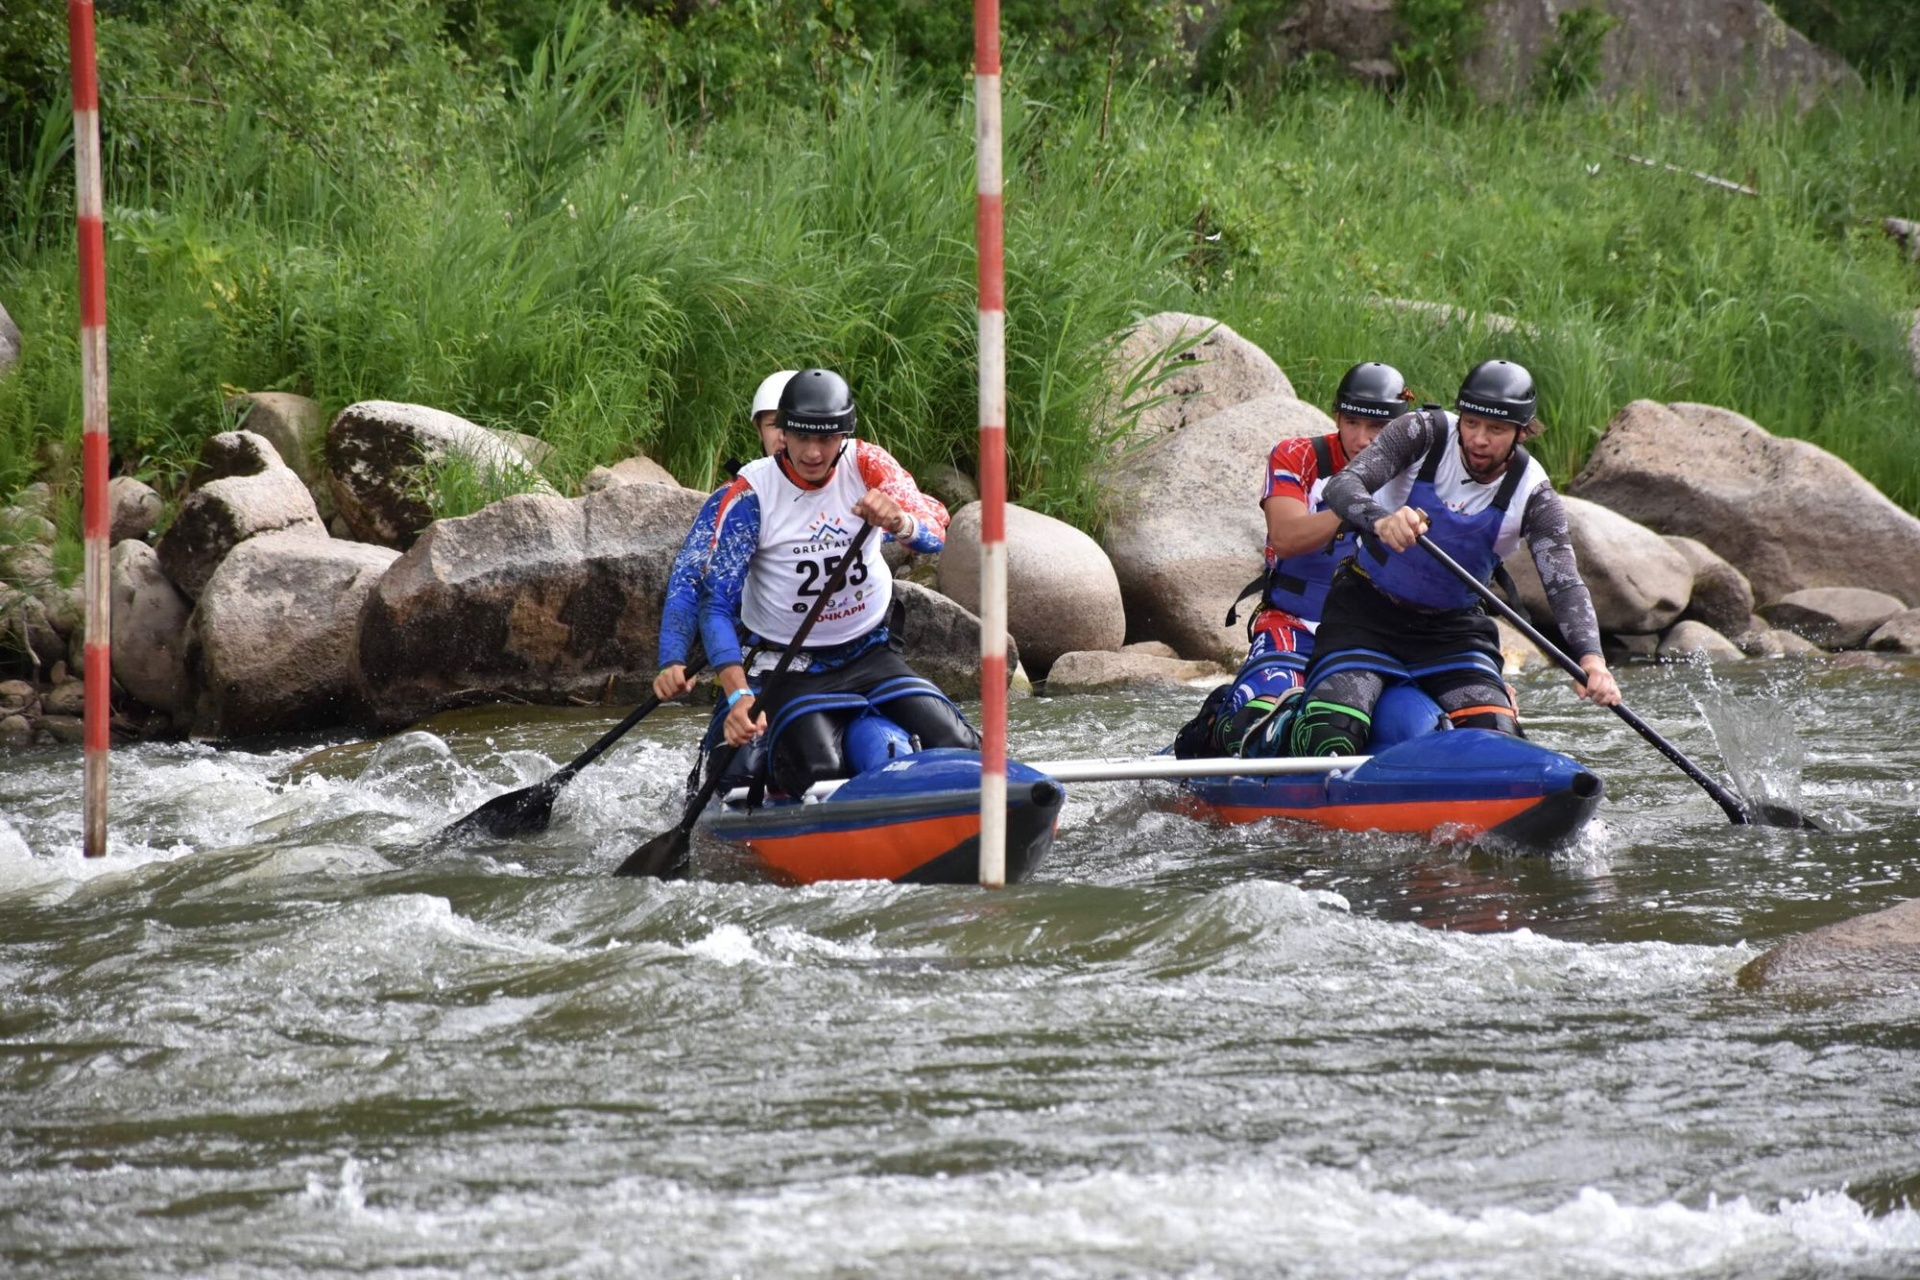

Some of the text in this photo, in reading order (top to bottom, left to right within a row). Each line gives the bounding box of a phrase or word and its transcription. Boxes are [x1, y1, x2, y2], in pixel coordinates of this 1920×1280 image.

[1341, 402, 1390, 416] panenka
[1459, 400, 1508, 416] panenka
[787, 420, 839, 430] panenka
[792, 537, 853, 554] GREAT ALT
[796, 549, 868, 597] 253
[816, 602, 866, 623] ОЧКАРИ
